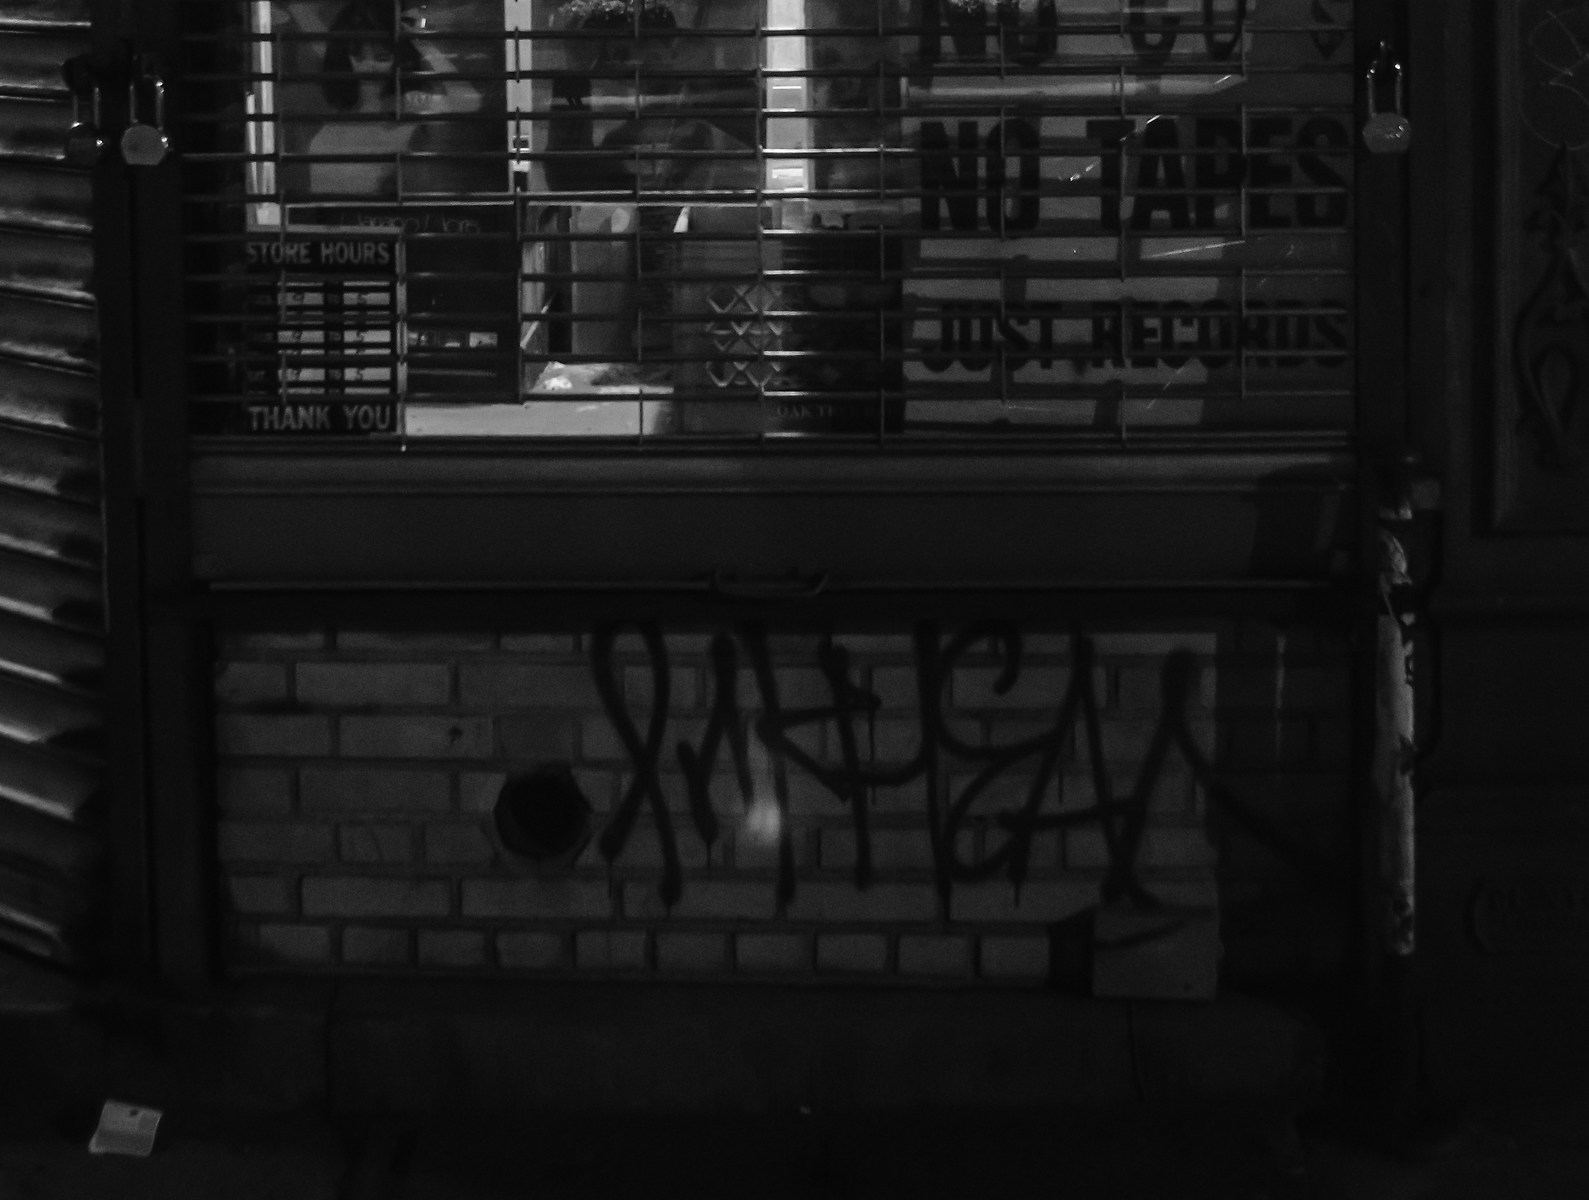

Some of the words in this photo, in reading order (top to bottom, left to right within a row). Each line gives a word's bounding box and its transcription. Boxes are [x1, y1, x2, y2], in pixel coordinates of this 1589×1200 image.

[920, 117, 1040, 230] NO
[1086, 117, 1349, 230] TAPES
[249, 242, 311, 265] STORE
[320, 242, 390, 265] HOURS
[923, 301, 1062, 372] JUST
[1092, 300, 1349, 370] RECORDS
[250, 405, 330, 430] THANK
[343, 405, 390, 430] YOU
